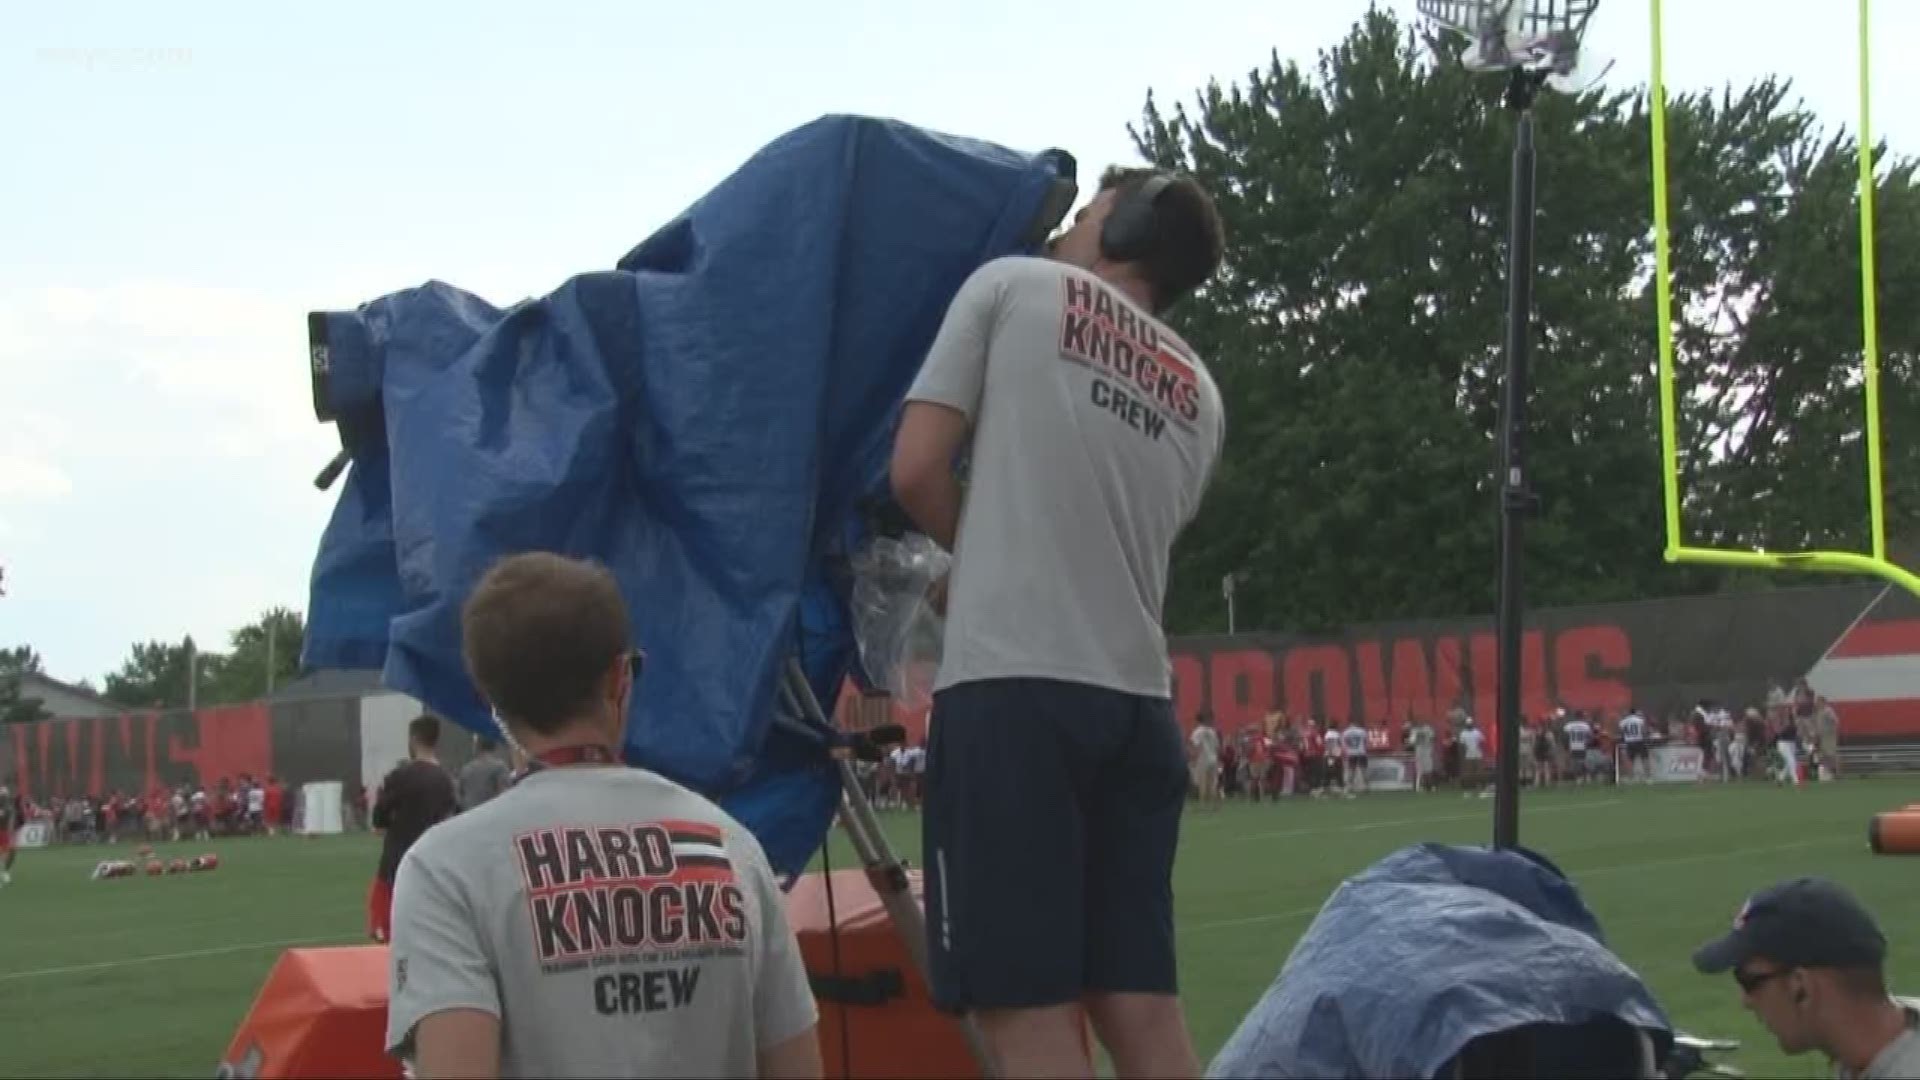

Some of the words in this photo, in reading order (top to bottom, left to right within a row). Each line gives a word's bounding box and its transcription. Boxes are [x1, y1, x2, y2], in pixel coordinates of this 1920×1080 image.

[1062, 275, 1161, 355] HARD
[1062, 312, 1202, 423] KNOCKS
[1090, 377, 1167, 441] CREW
[516, 823, 678, 890] HARD
[530, 881, 748, 961] KNOCKS
[593, 965, 700, 1016] CREW
